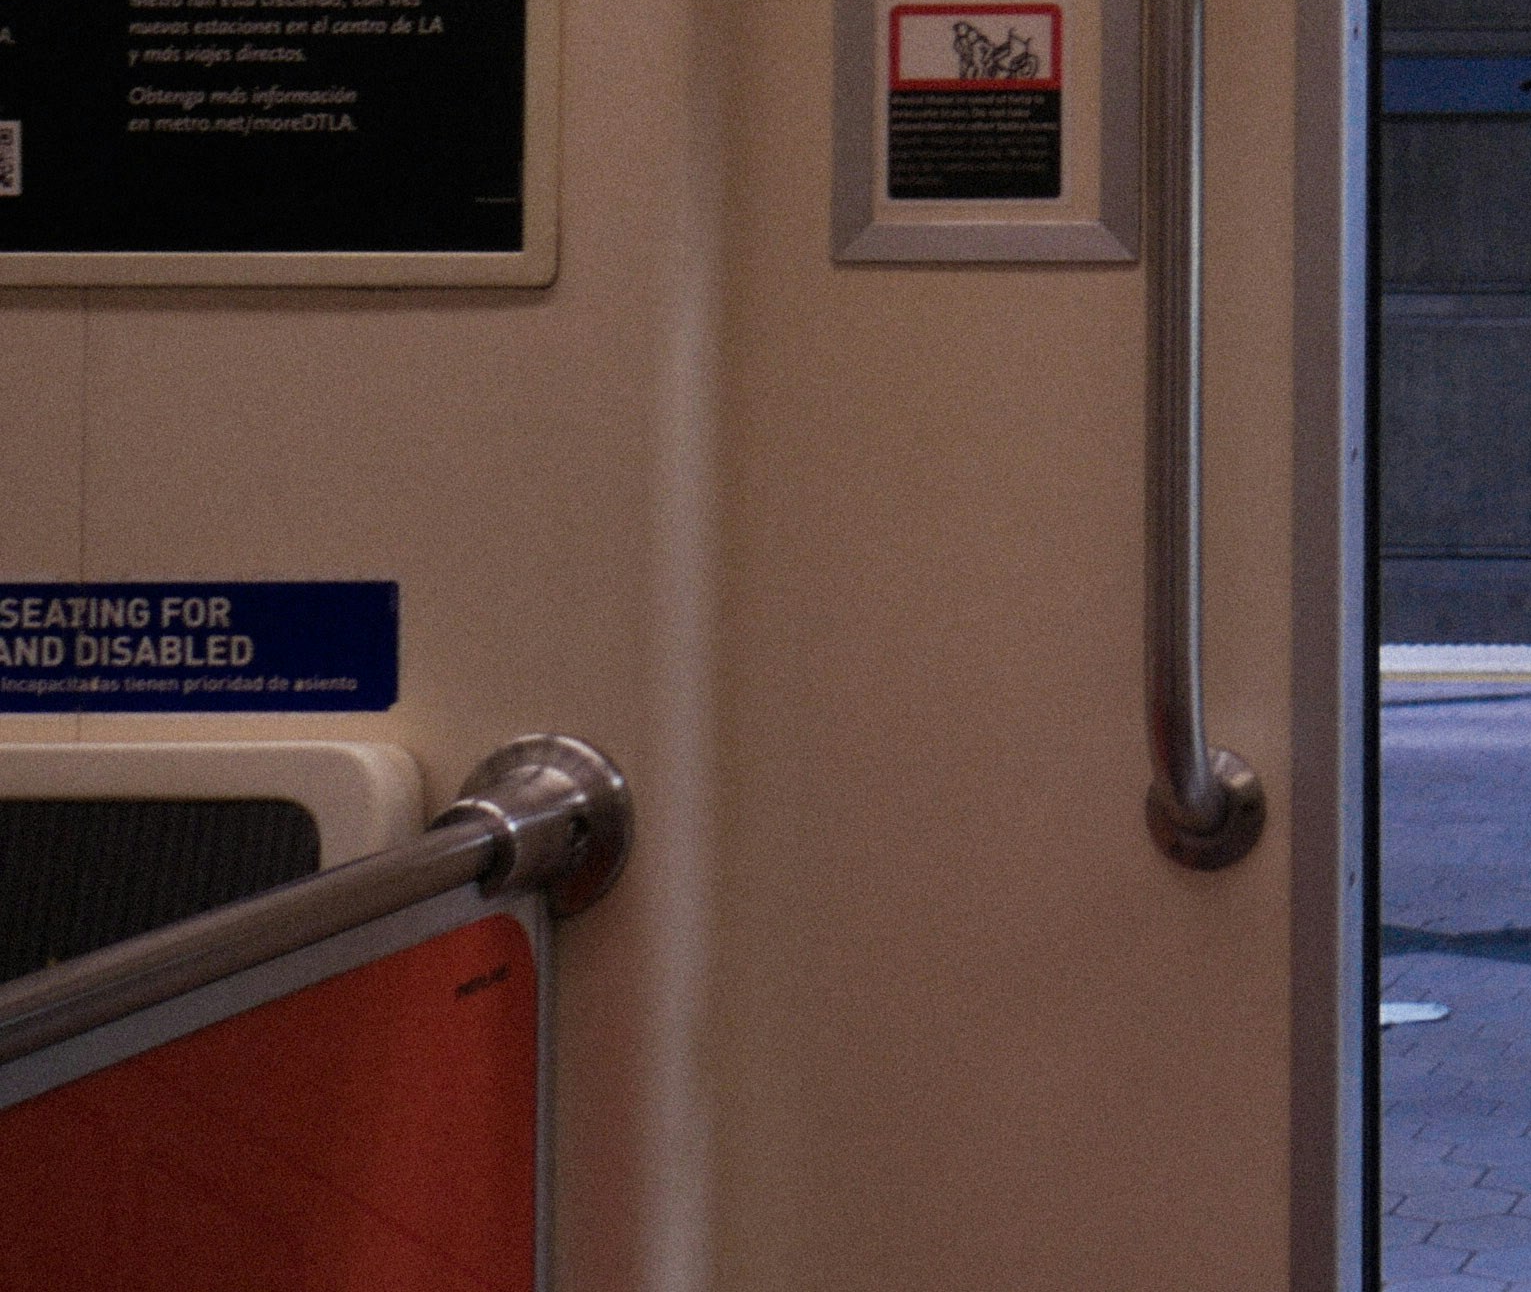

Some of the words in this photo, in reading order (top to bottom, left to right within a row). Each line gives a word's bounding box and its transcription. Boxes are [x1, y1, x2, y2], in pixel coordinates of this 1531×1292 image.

[194, 17, 282, 35] estaciones
[285, 20, 309, 34] en
[312, 15, 330, 34] el
[332, 17, 388, 34] centro
[390, 15, 413, 34] de
[417, 16, 445, 33] LA
[128, 50, 139, 67] y
[143, 45, 180, 62] más
[184, 45, 233, 68] viajes
[236, 44, 307, 63] directos.
[128, 87, 205, 110] Obtenga
[209, 86, 248, 104] más
[251, 86, 358, 110] información
[128, 118, 151, 133] en
[154, 114, 358, 136] metro.net/moreDTLA.
[0, 595, 151, 629] SEATING
[160, 595, 232, 629] FOR
[0, 634, 66, 668] AND
[75, 633, 256, 668] DISABLED
[123, 675, 179, 692] tienen
[183, 675, 264, 696] prioridad
[267, 674, 289, 692] de
[293, 674, 358, 692] asiento
